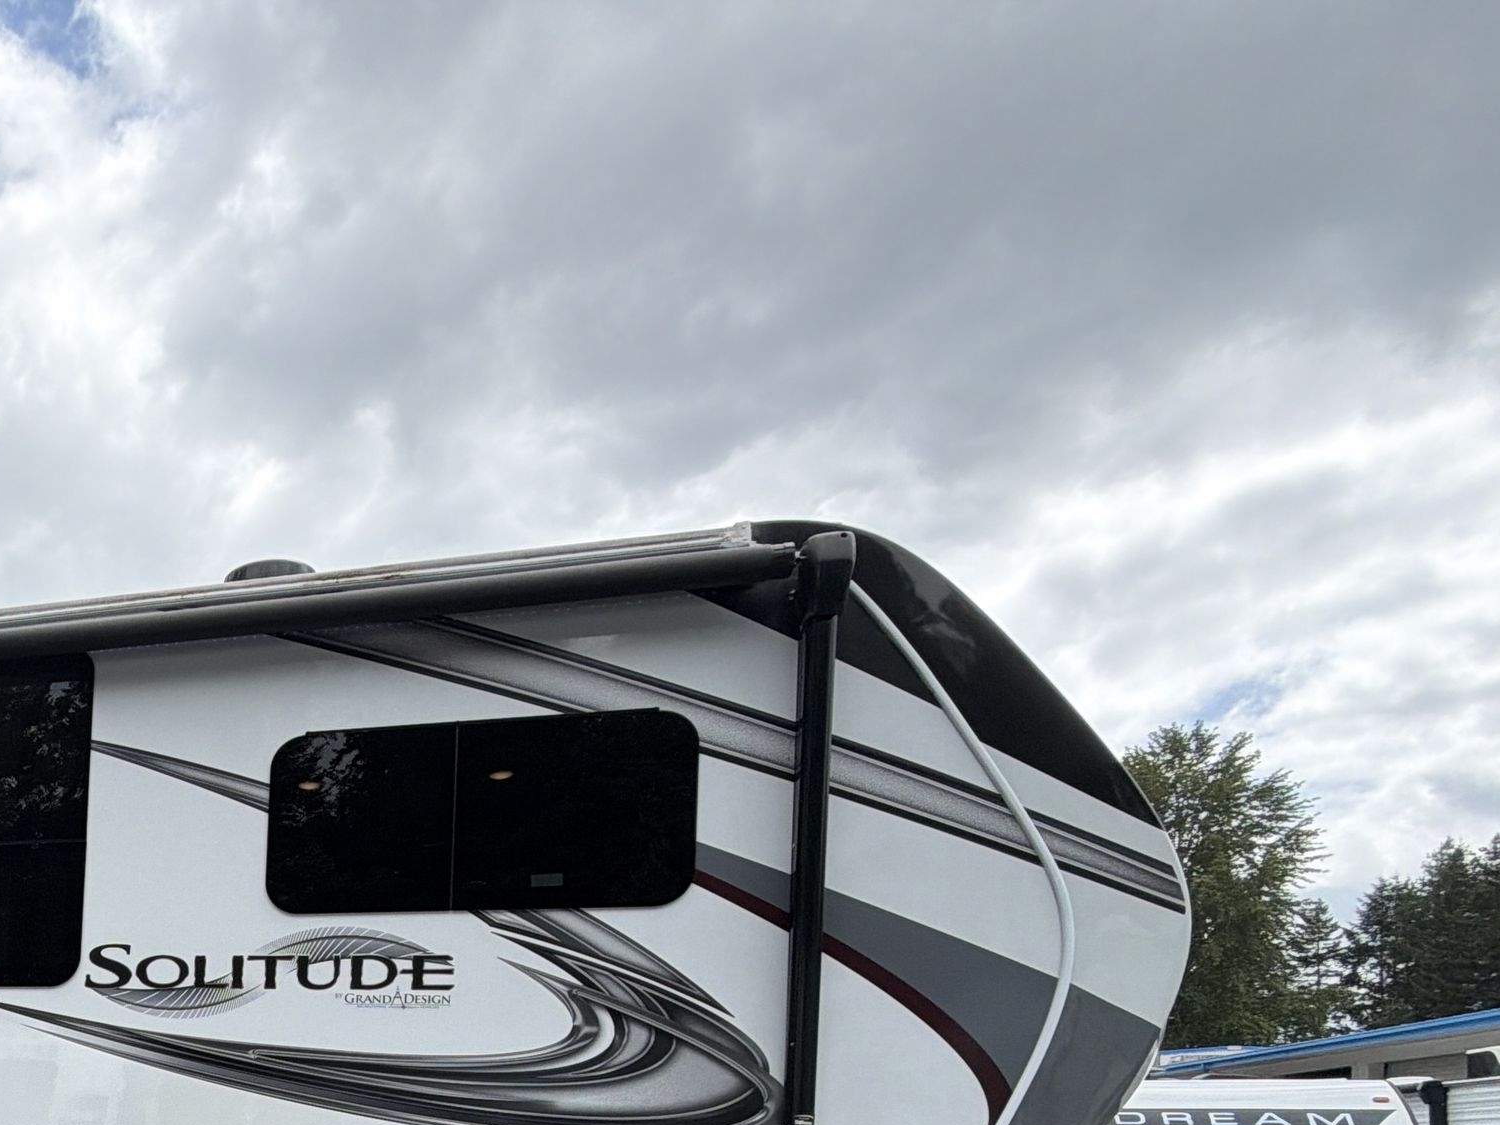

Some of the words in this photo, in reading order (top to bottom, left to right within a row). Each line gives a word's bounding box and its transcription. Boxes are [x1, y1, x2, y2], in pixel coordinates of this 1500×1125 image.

[84, 943, 455, 991] SOLITUDE
[344, 992, 392, 1004] GRAND
[404, 992, 452, 1005] DESIGN
